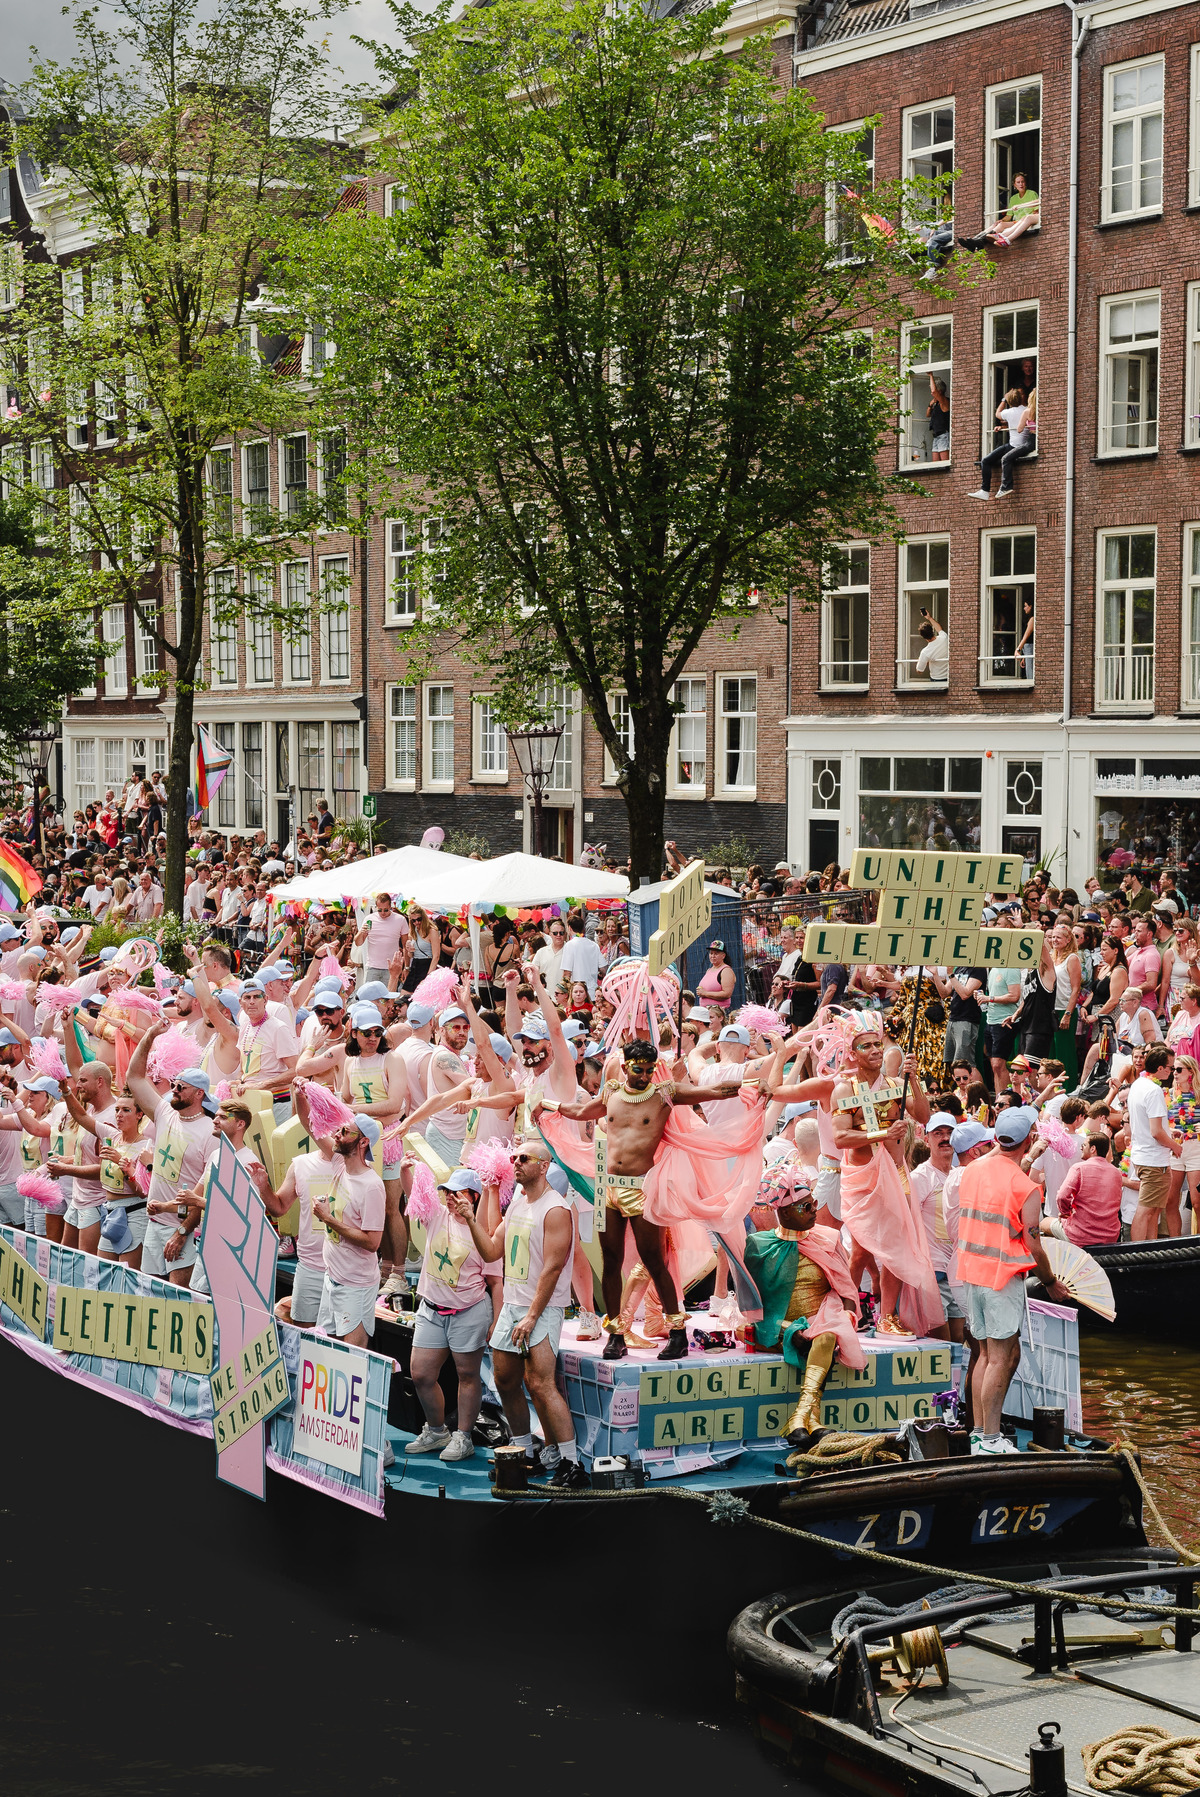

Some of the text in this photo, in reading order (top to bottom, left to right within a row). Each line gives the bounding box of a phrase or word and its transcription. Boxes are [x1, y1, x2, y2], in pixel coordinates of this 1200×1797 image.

[863, 857, 1013, 886] UNITE
[671, 869, 703, 918] JOIN
[893, 896, 976, 921] THE
[660, 898, 709, 965] FORCES
[816, 931, 1034, 960] LETTERS
[359, 1082, 373, 1103] T
[596, 1142, 604, 1229] LGBTQIA+
[60, 1297, 207, 1358] LETTERS
[213, 1367, 234, 1401] WE
[244, 1331, 274, 1377] ARE
[897, 1355, 943, 1377] WE
[217, 1369, 284, 1443] STRONG
[301, 1359, 362, 1425] PRIDE
[299, 1413, 359, 1452] AMSTERDAM
[661, 1399, 928, 1440] ARE SRONG
[978, 1504, 1050, 1537] 1275
